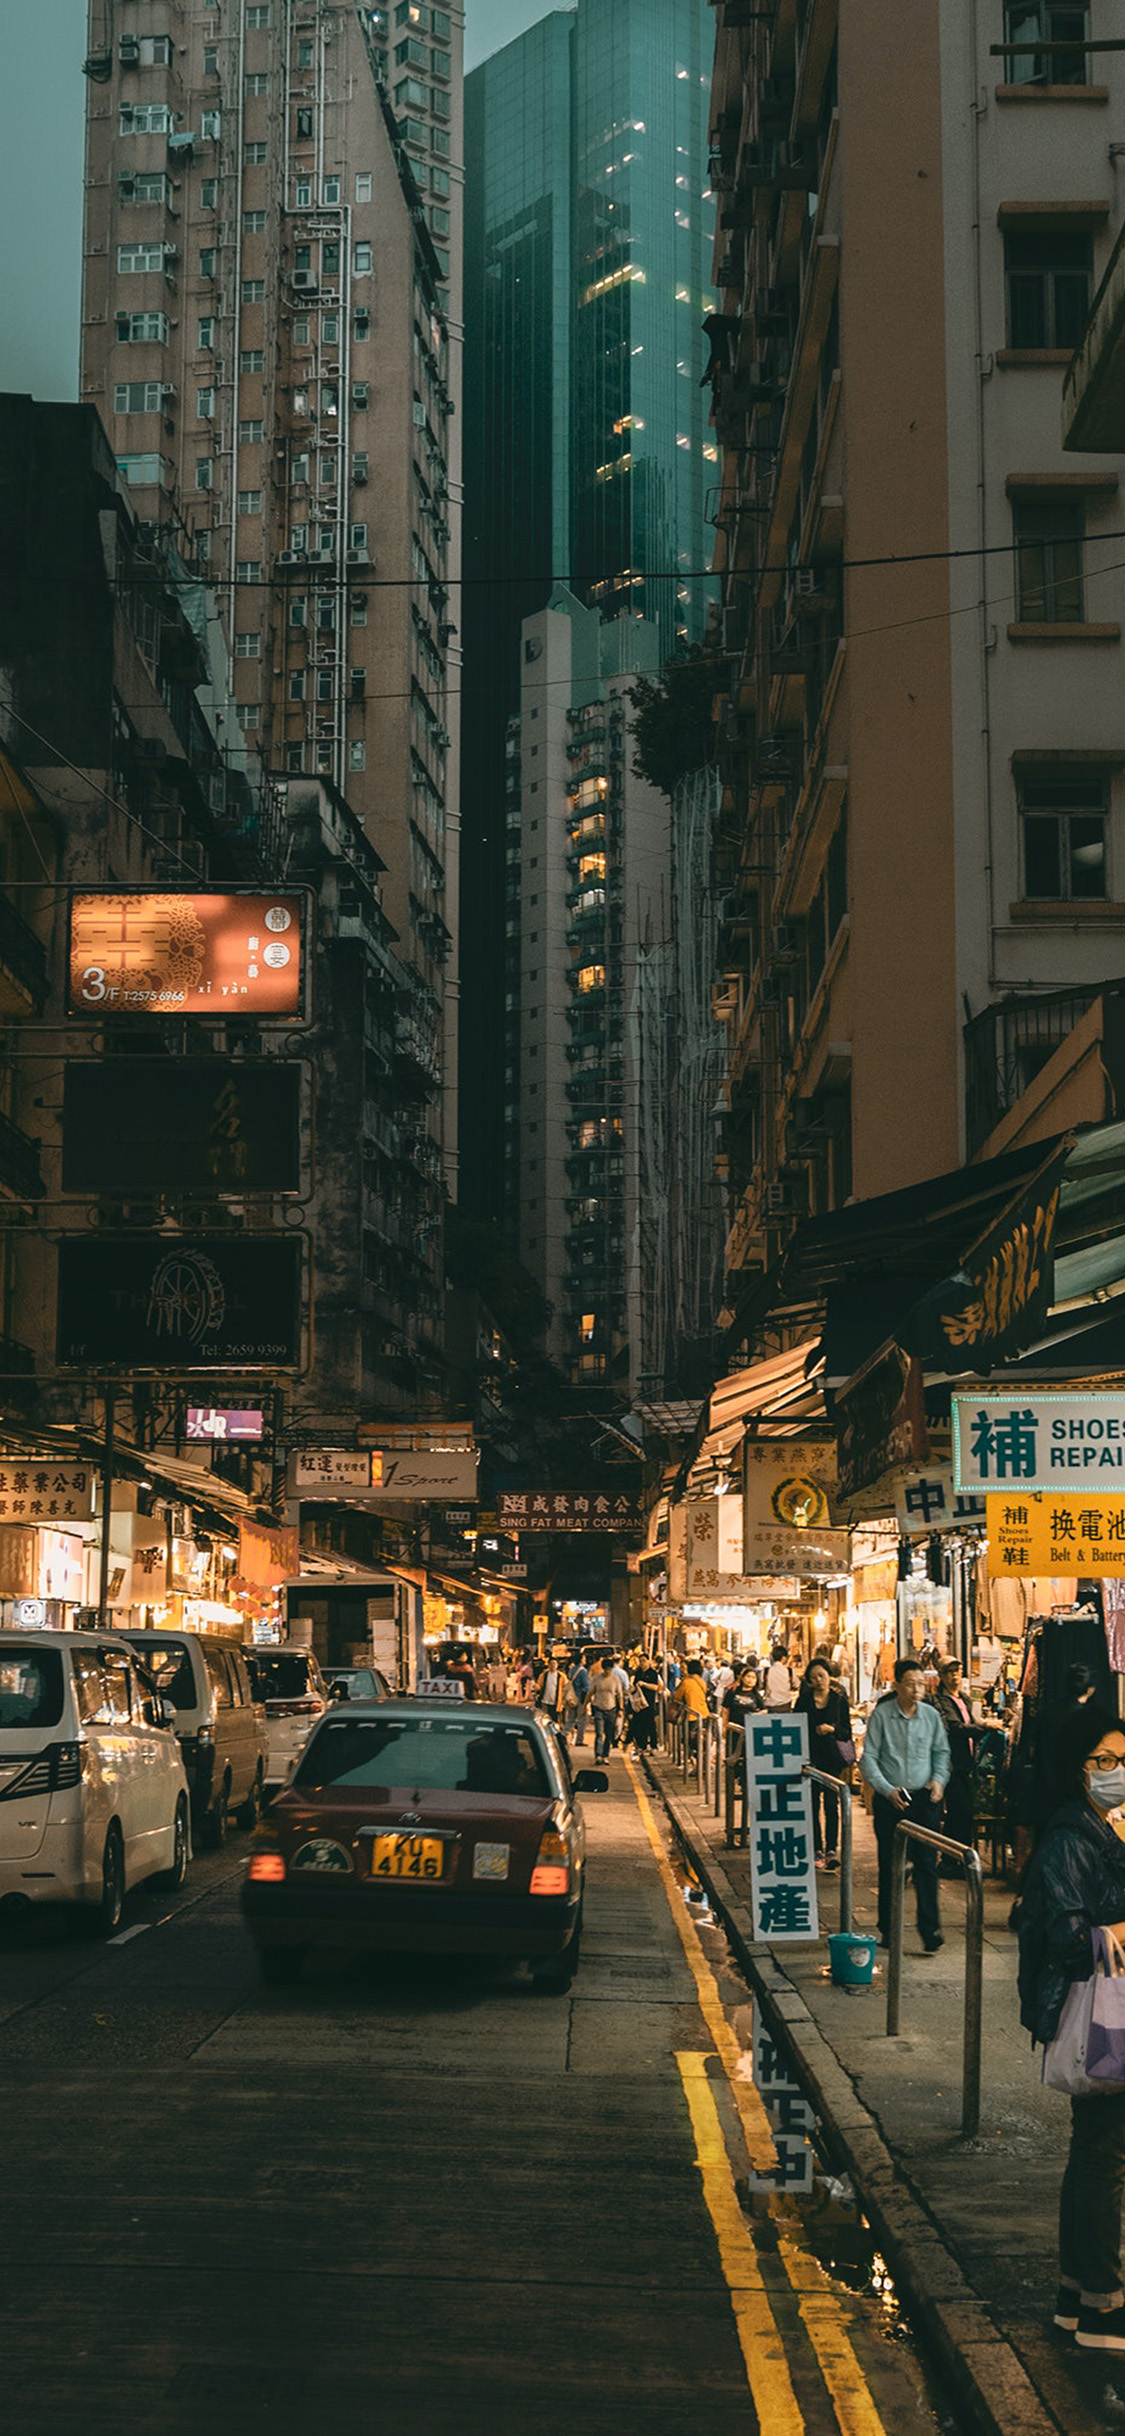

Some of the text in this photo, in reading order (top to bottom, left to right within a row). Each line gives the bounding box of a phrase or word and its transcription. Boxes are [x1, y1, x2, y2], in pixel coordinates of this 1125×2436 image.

[159, 990, 185, 1001] 6966
[200, 1344, 221, 1355] Tel:
[225, 1344, 254, 1356] 2659
[258, 1344, 288, 1356] 9399
[1052, 1419, 1125, 1440] SHOE
[971, 1409, 1039, 1479] 補
[499, 1518, 527, 1528] SING
[531, 1518, 552, 1528] FAT
[556, 1518, 589, 1528] MEAT
[592, 1518, 644, 1528] COMPAN
[1002, 1506, 1029, 1525] 補
[998, 1527, 1029, 1535] Shoes
[998, 1535, 1033, 1545] Repair
[1002, 1547, 1030, 1566] 鞋
[1050, 1547, 1071, 1561] Belt
[1077, 1549, 1085, 1561] &
[422, 1681, 459, 1694] TAXI
[752, 1718, 812, 1933] 中正地產
[394, 1836, 423, 1857] KU
[378, 1857, 438, 1876] 4146
